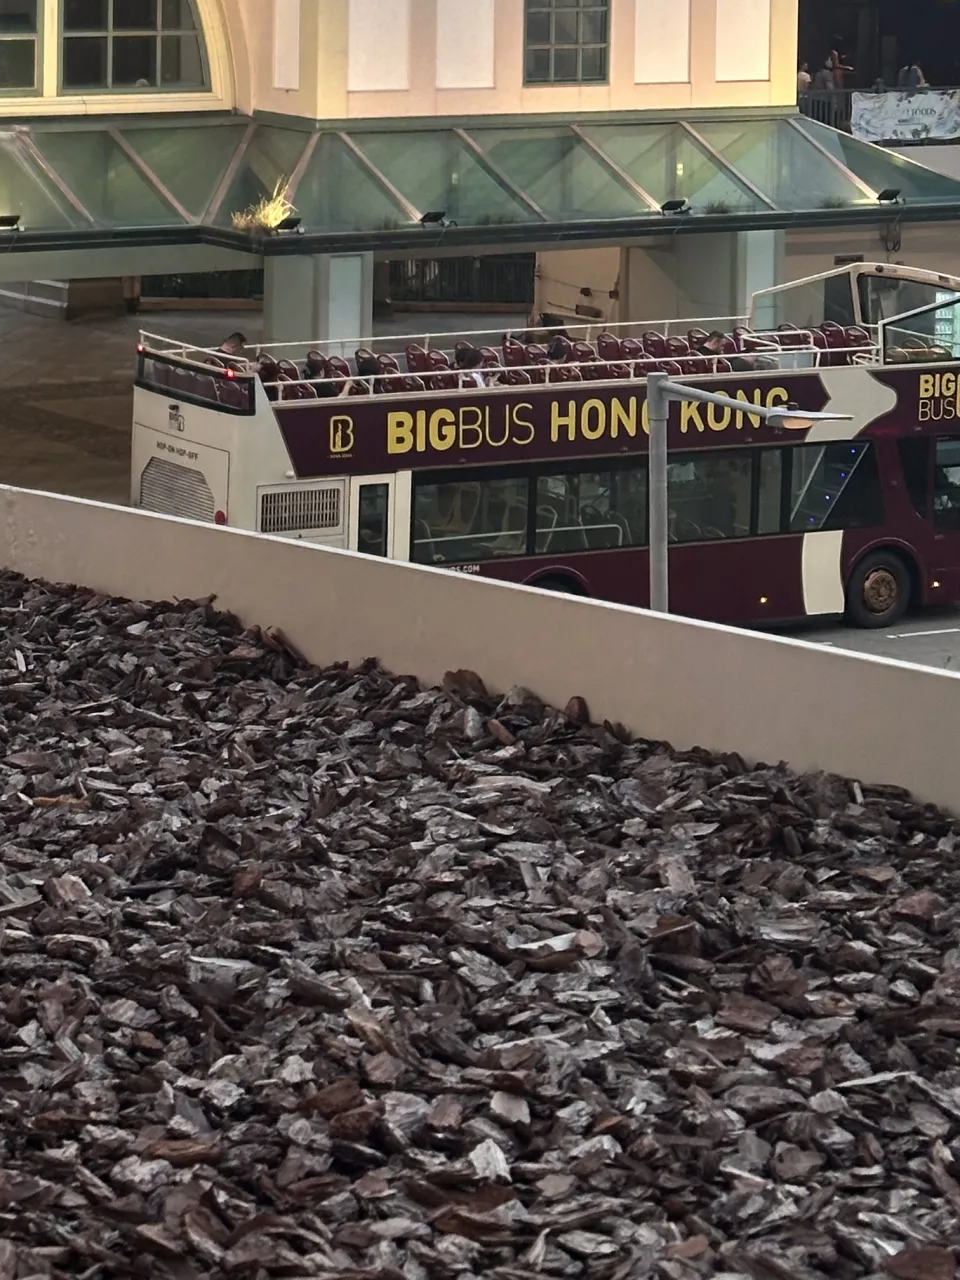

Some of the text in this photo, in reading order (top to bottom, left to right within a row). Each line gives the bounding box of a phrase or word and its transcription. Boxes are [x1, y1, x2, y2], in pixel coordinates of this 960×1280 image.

[919, 372, 956, 398] BIG
[918, 398, 955, 421] BUS
[387, 403, 535, 454] BIGBUS
